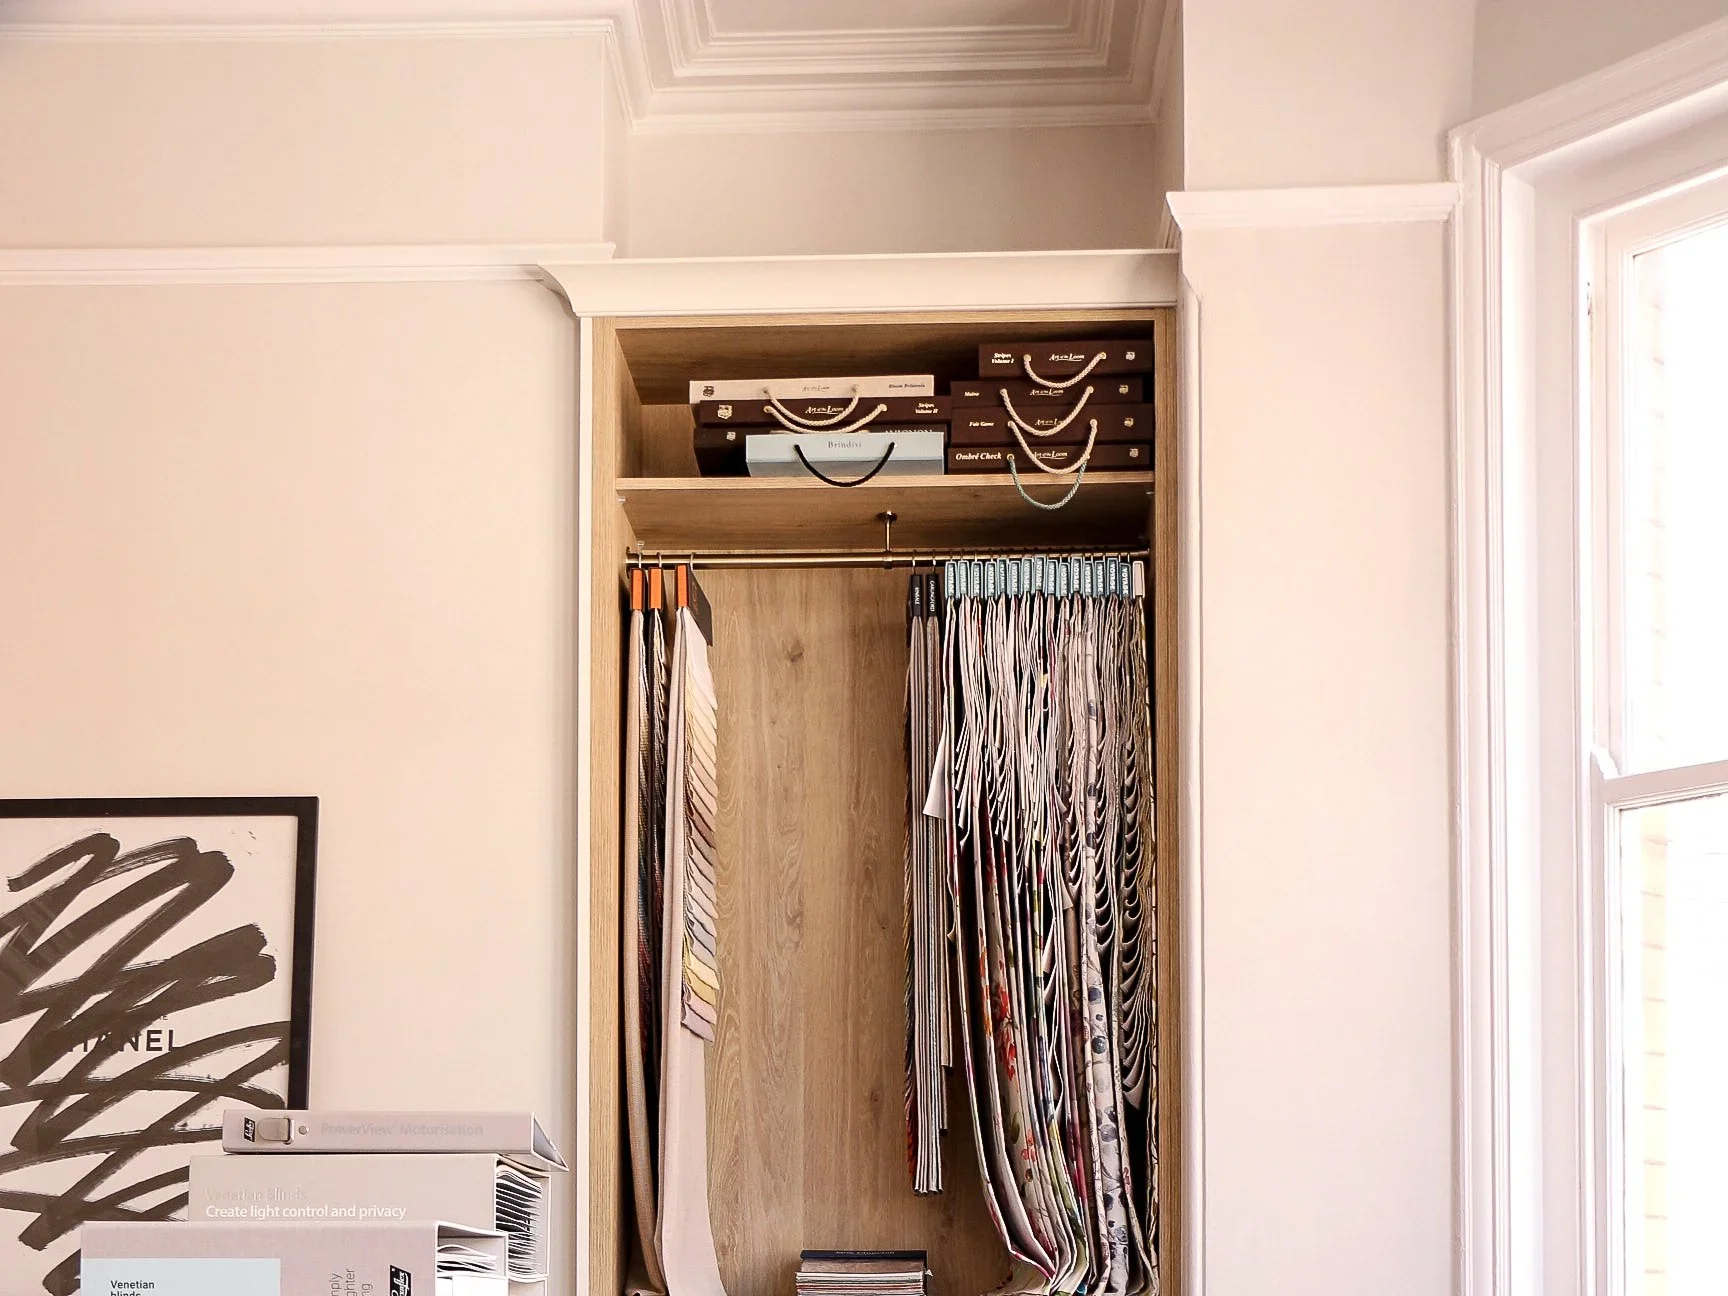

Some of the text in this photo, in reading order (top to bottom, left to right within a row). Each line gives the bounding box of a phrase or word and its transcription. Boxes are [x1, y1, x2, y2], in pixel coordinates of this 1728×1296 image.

[828, 440, 862, 449] Brindisi
[980, 452, 1002, 460] Check
[206, 1205, 407, 1221] Create light control and privacy
[110, 1280, 155, 1290] Venetian
